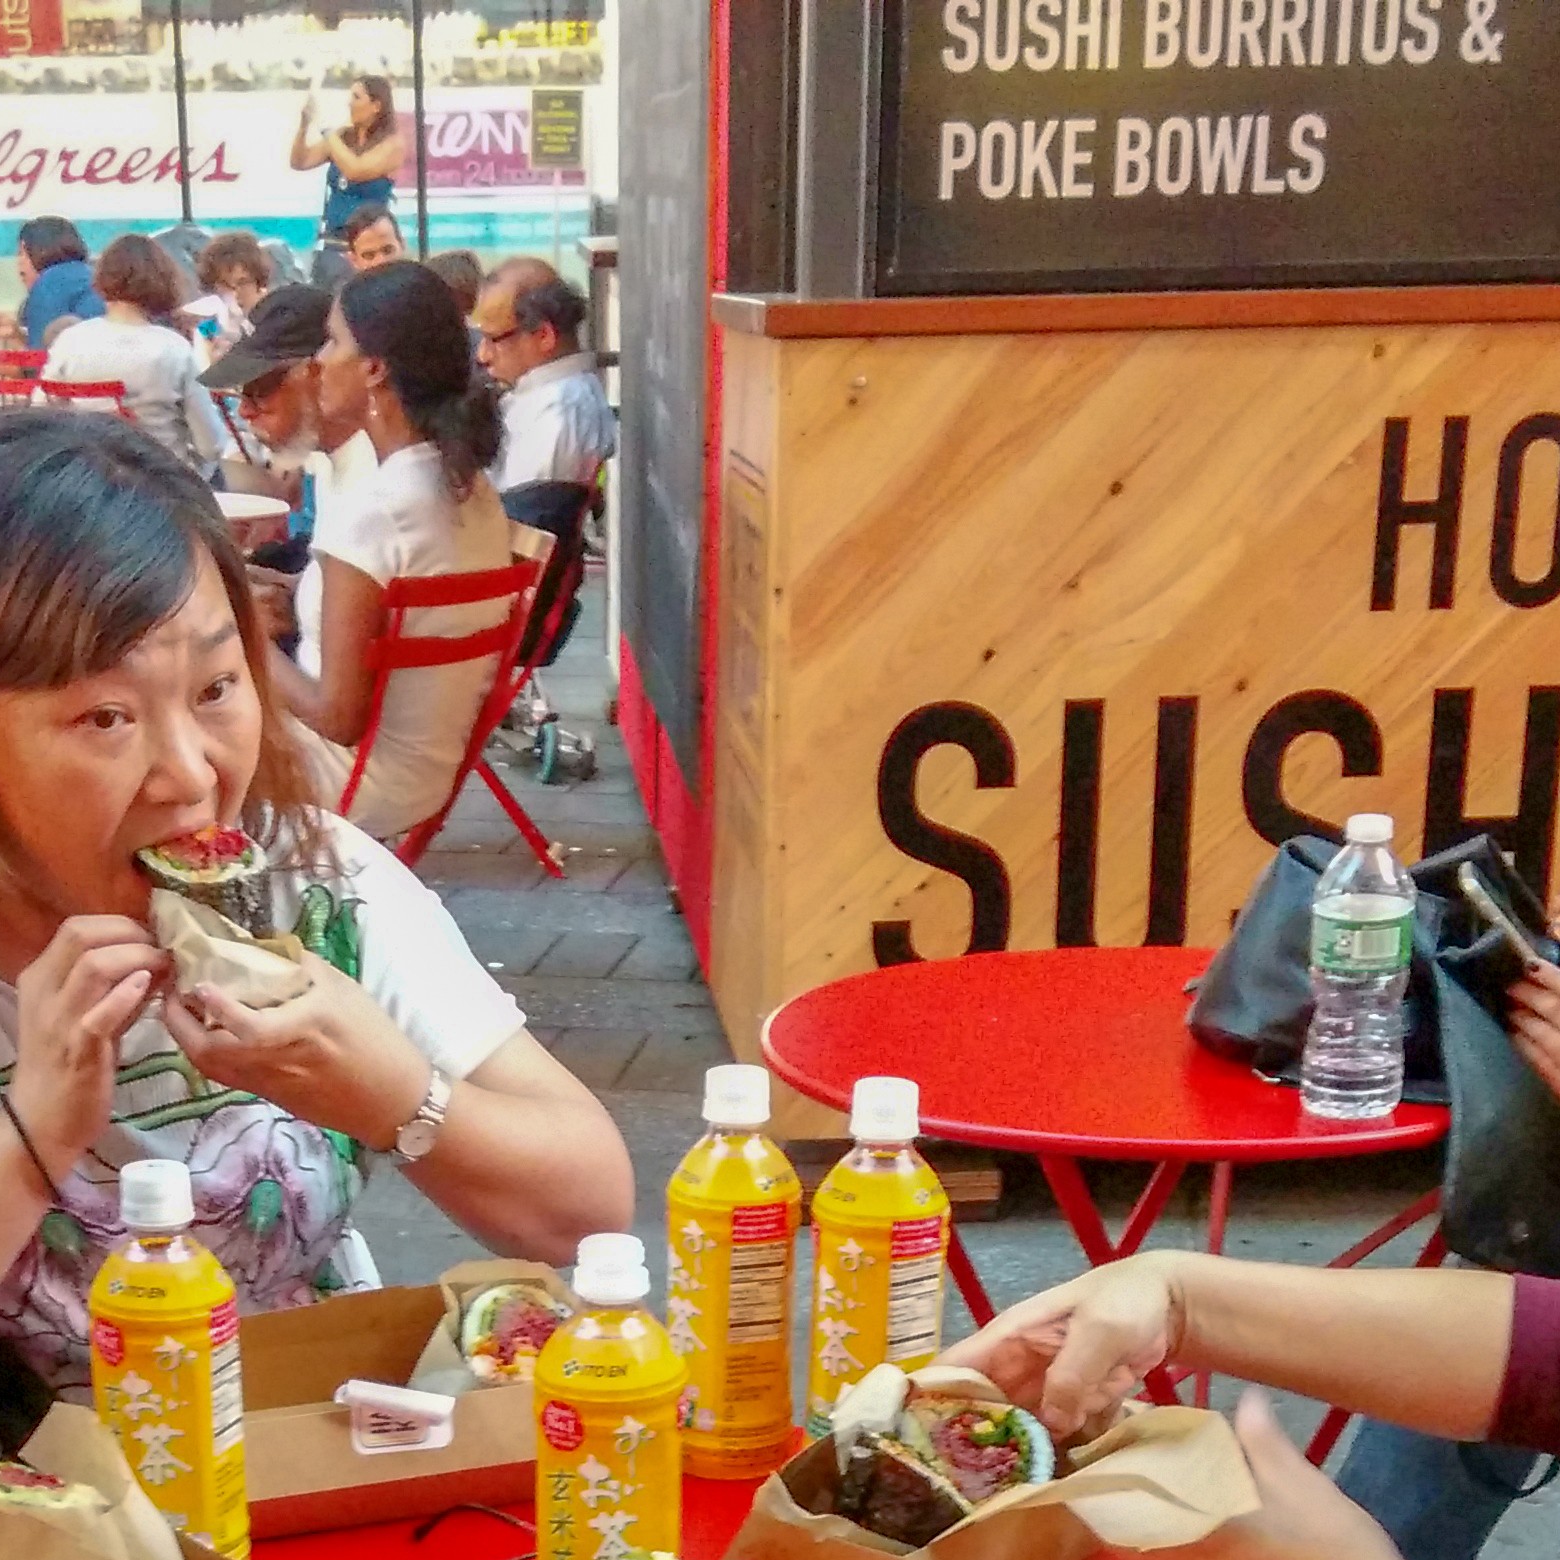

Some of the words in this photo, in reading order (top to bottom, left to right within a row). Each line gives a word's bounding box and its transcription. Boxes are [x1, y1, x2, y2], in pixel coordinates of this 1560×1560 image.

[942, 0, 1120, 73] SUSHI
[1142, 0, 1439, 69] BURRITOS
[1458, 0, 1503, 65] &
[938, 117, 1097, 201] POKE
[1112, 112, 1329, 197] BOWLS
